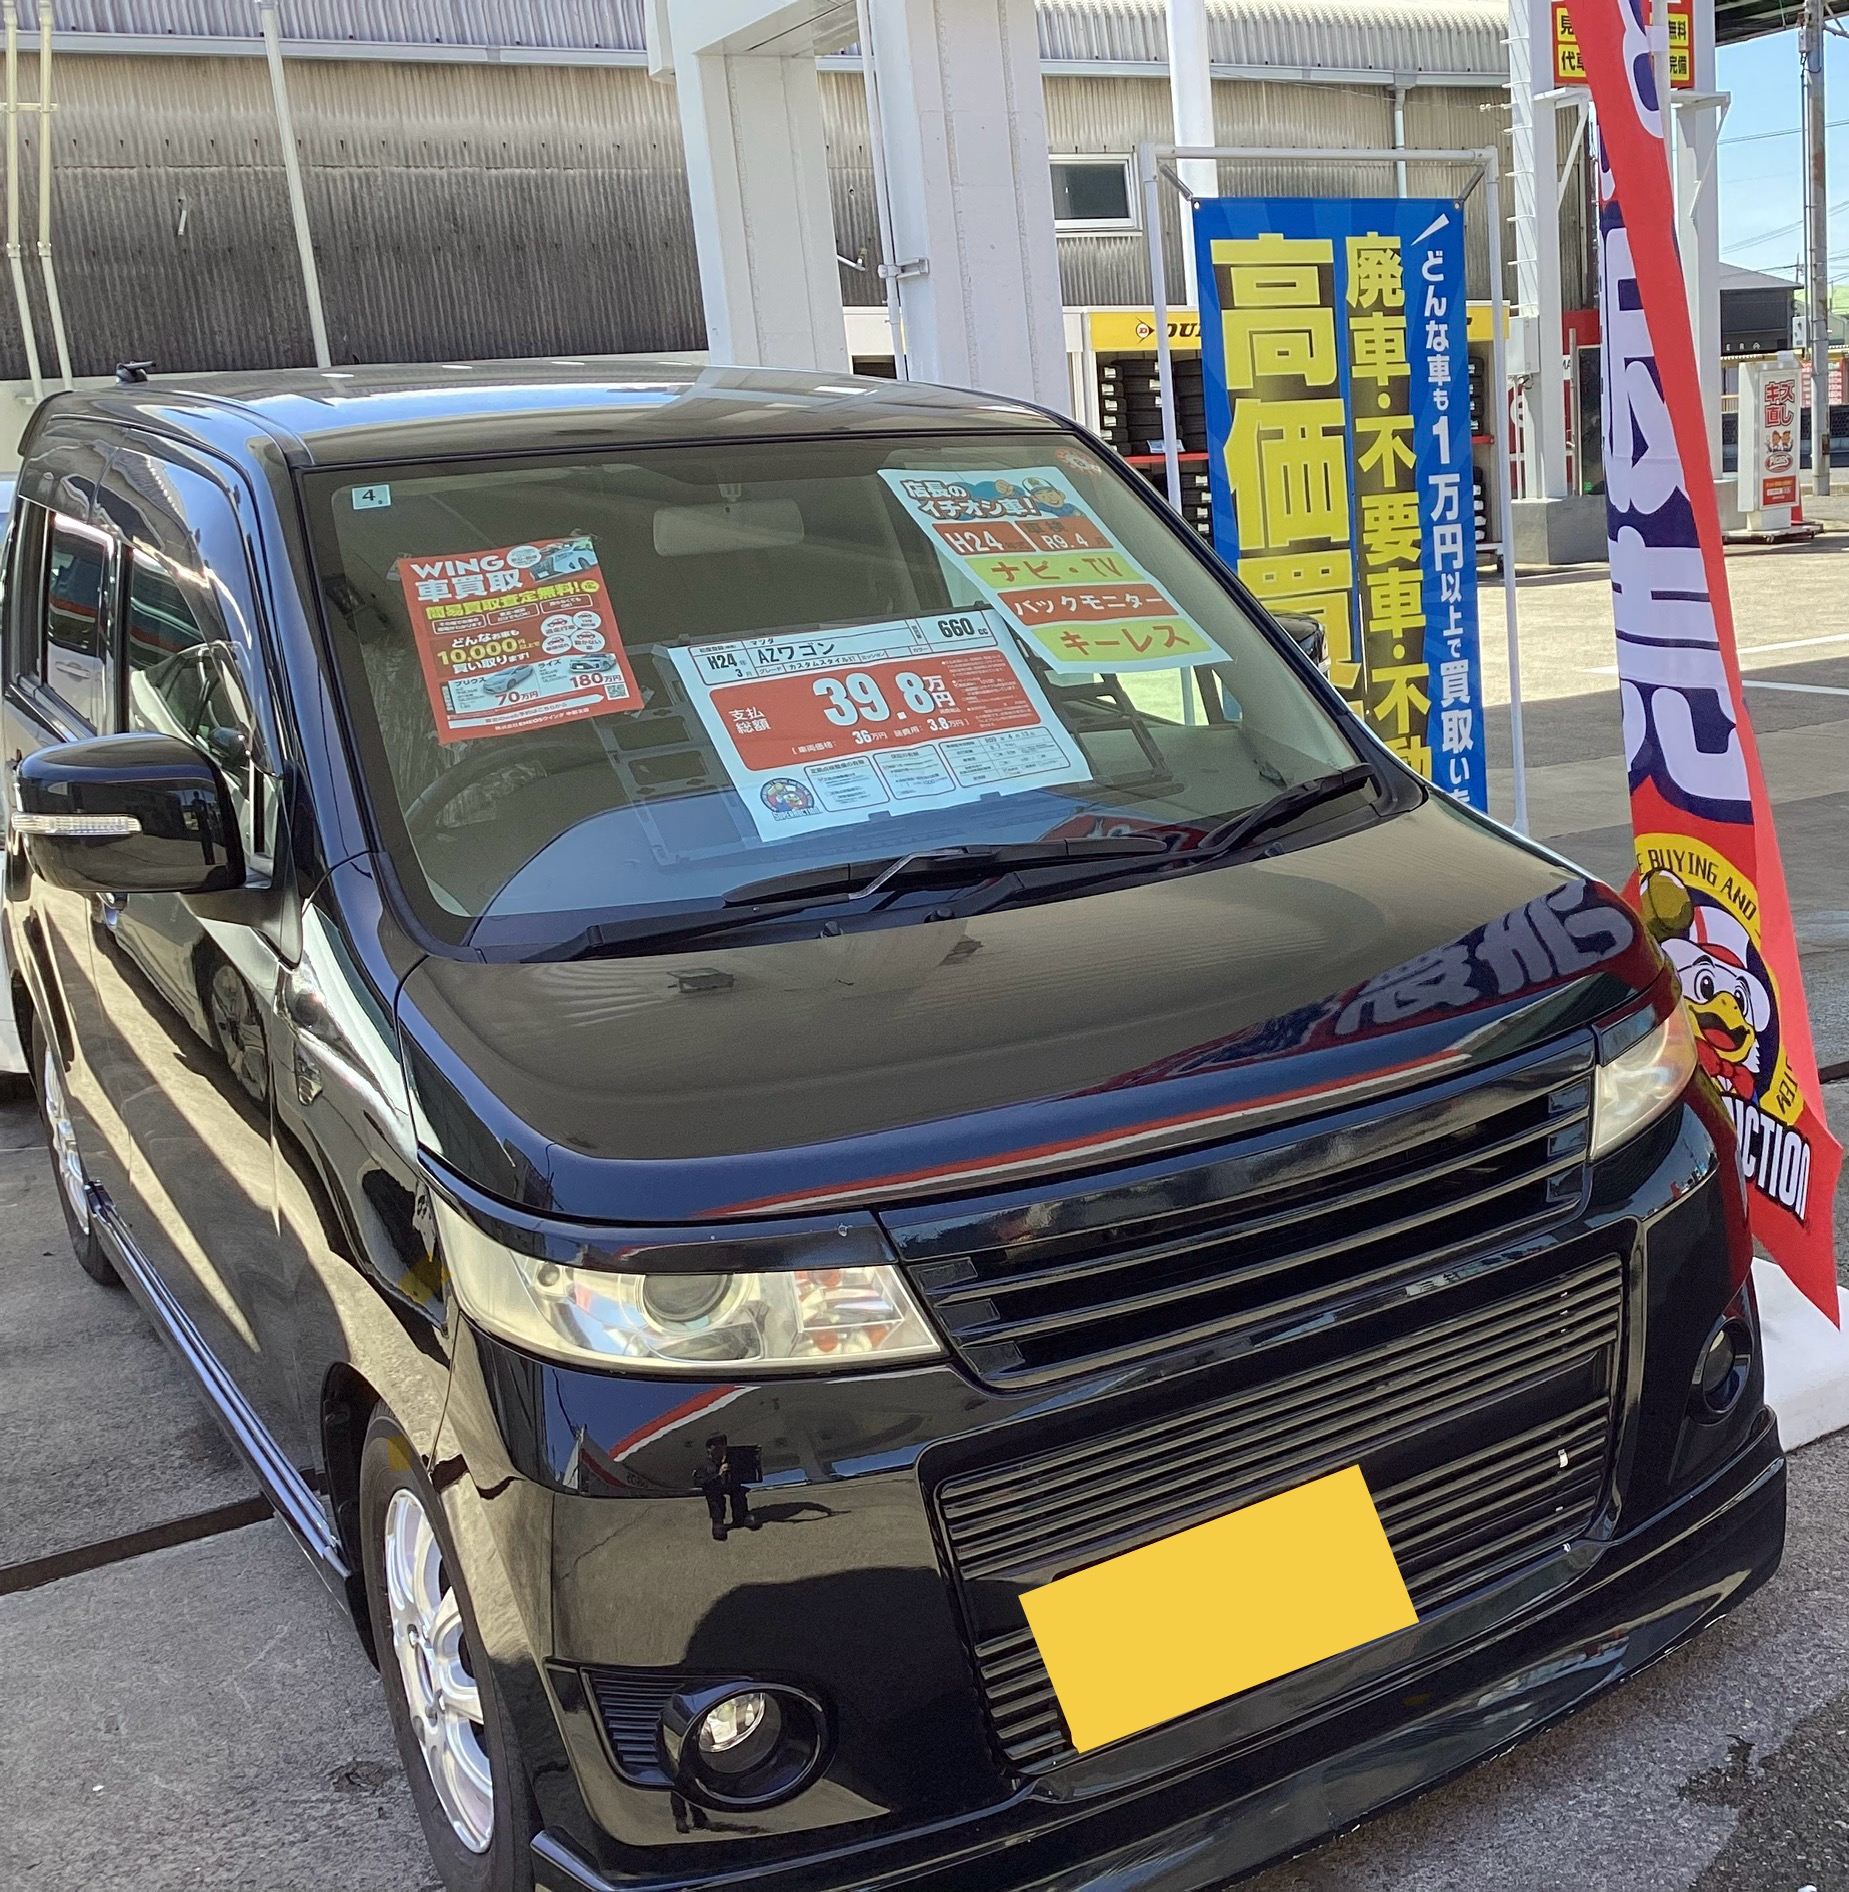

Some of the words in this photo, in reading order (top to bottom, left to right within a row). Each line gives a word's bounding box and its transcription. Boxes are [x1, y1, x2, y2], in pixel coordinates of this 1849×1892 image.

[1764, 380, 1795, 404] キズ
[1764, 404, 1795, 428] 直し
[362, 488, 376, 501] 4
[902, 480, 968, 499] 店長の
[920, 498, 1037, 517] イチオシ車!
[943, 530, 1005, 553] H24
[410, 555, 505, 579] WING
[415, 569, 524, 602] 車買取
[425, 581, 581, 620] 簡易買取査定無料!
[1013, 593, 1163, 617] バックモニター
[451, 629, 520, 648] どんなお車も
[937, 617, 976, 638] 660
[1060, 624, 1190, 656] キーレス
[452, 651, 530, 675] 買い取ります!
[706, 652, 738, 670] H24
[757, 642, 836, 665] AZワゴン
[569, 672, 622, 688] 180万円
[734, 668, 744, 678] 3
[495, 690, 539, 706] 70万円
[812, 671, 936, 727] 39.8
[728, 706, 765, 722] 支払
[735, 718, 772, 734] 総額
[851, 729, 888, 745] 36万円
[1647, 849, 1719, 887] BUYING
[1719, 876, 1757, 920] AND
